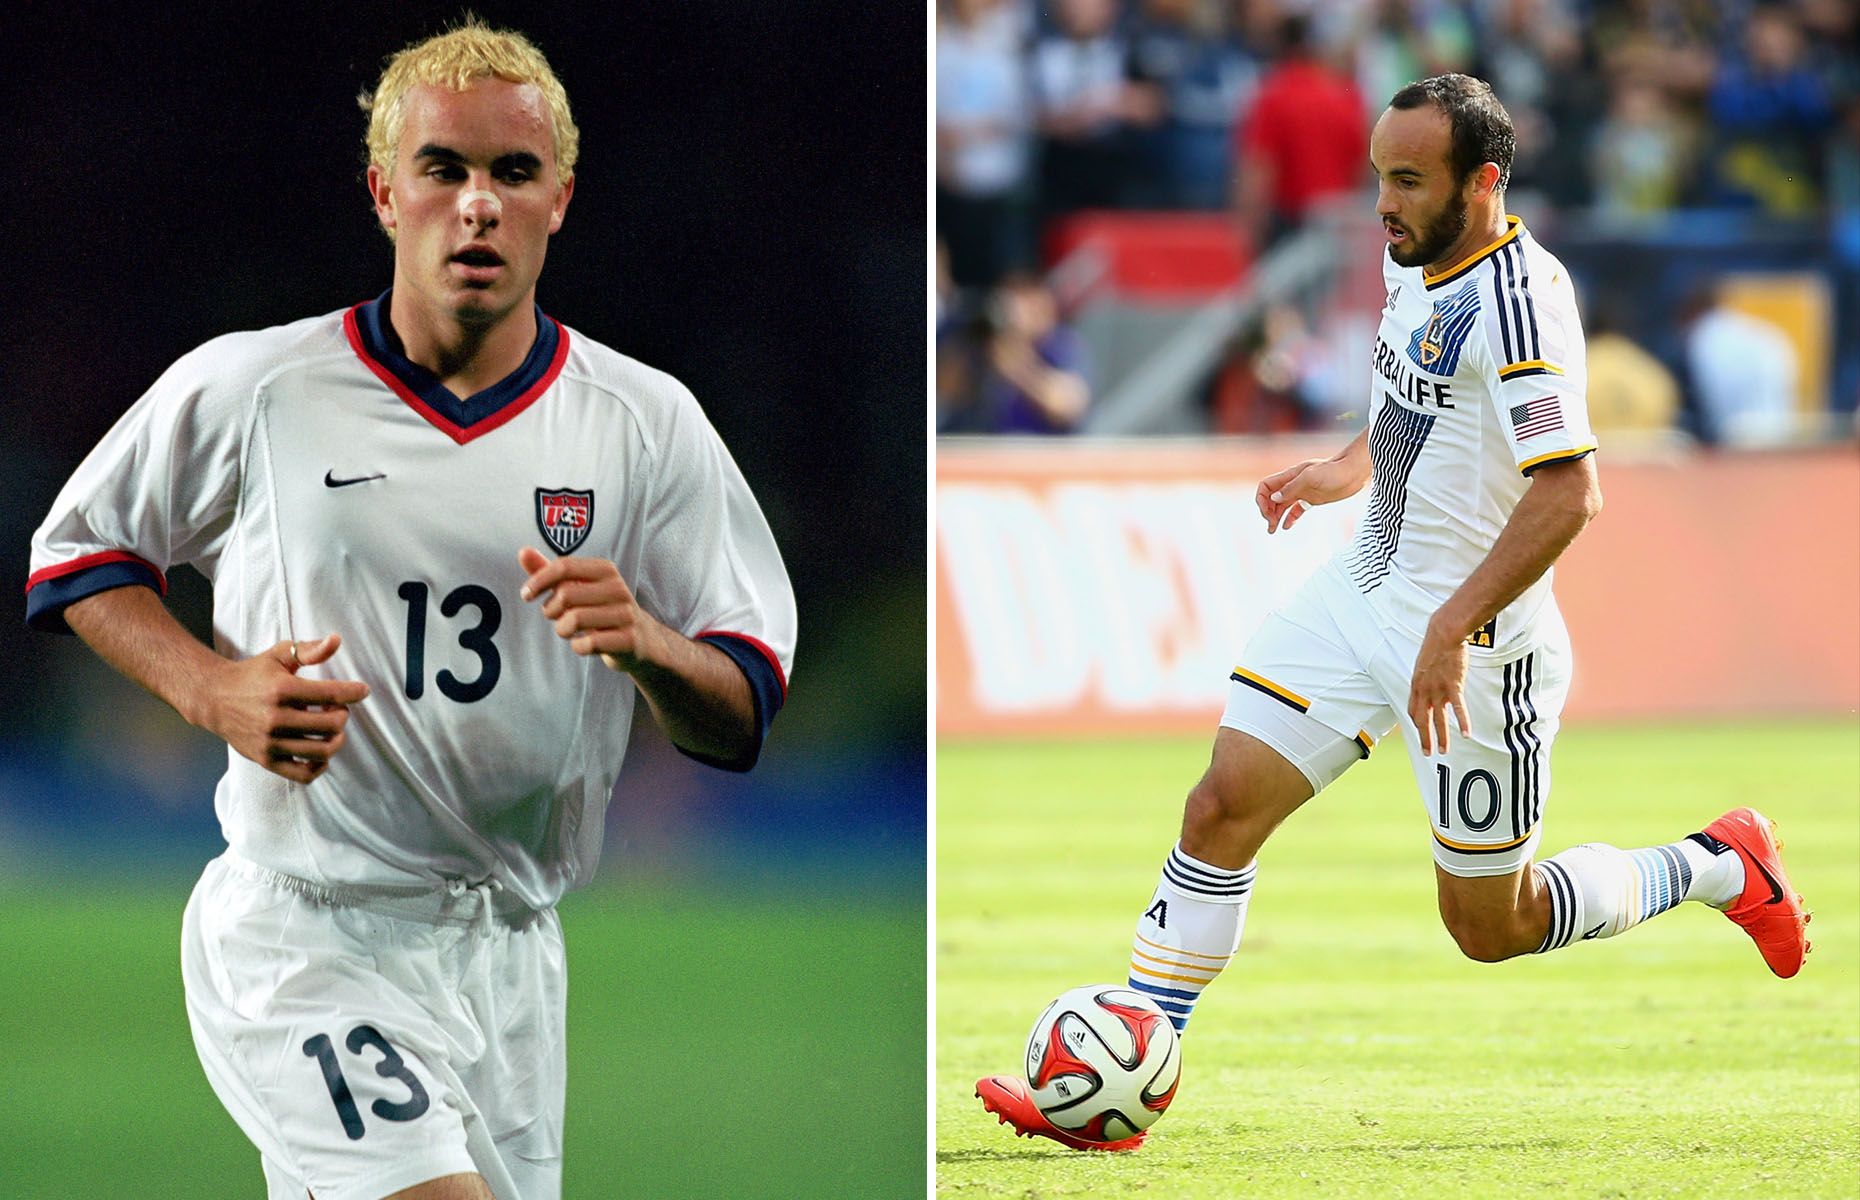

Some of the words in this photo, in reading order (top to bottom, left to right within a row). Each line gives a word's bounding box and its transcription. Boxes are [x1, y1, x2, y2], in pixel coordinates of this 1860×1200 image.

[398, 581, 502, 704] 13
[1437, 763, 1502, 832] 10
[302, 1024, 430, 1141] 13
